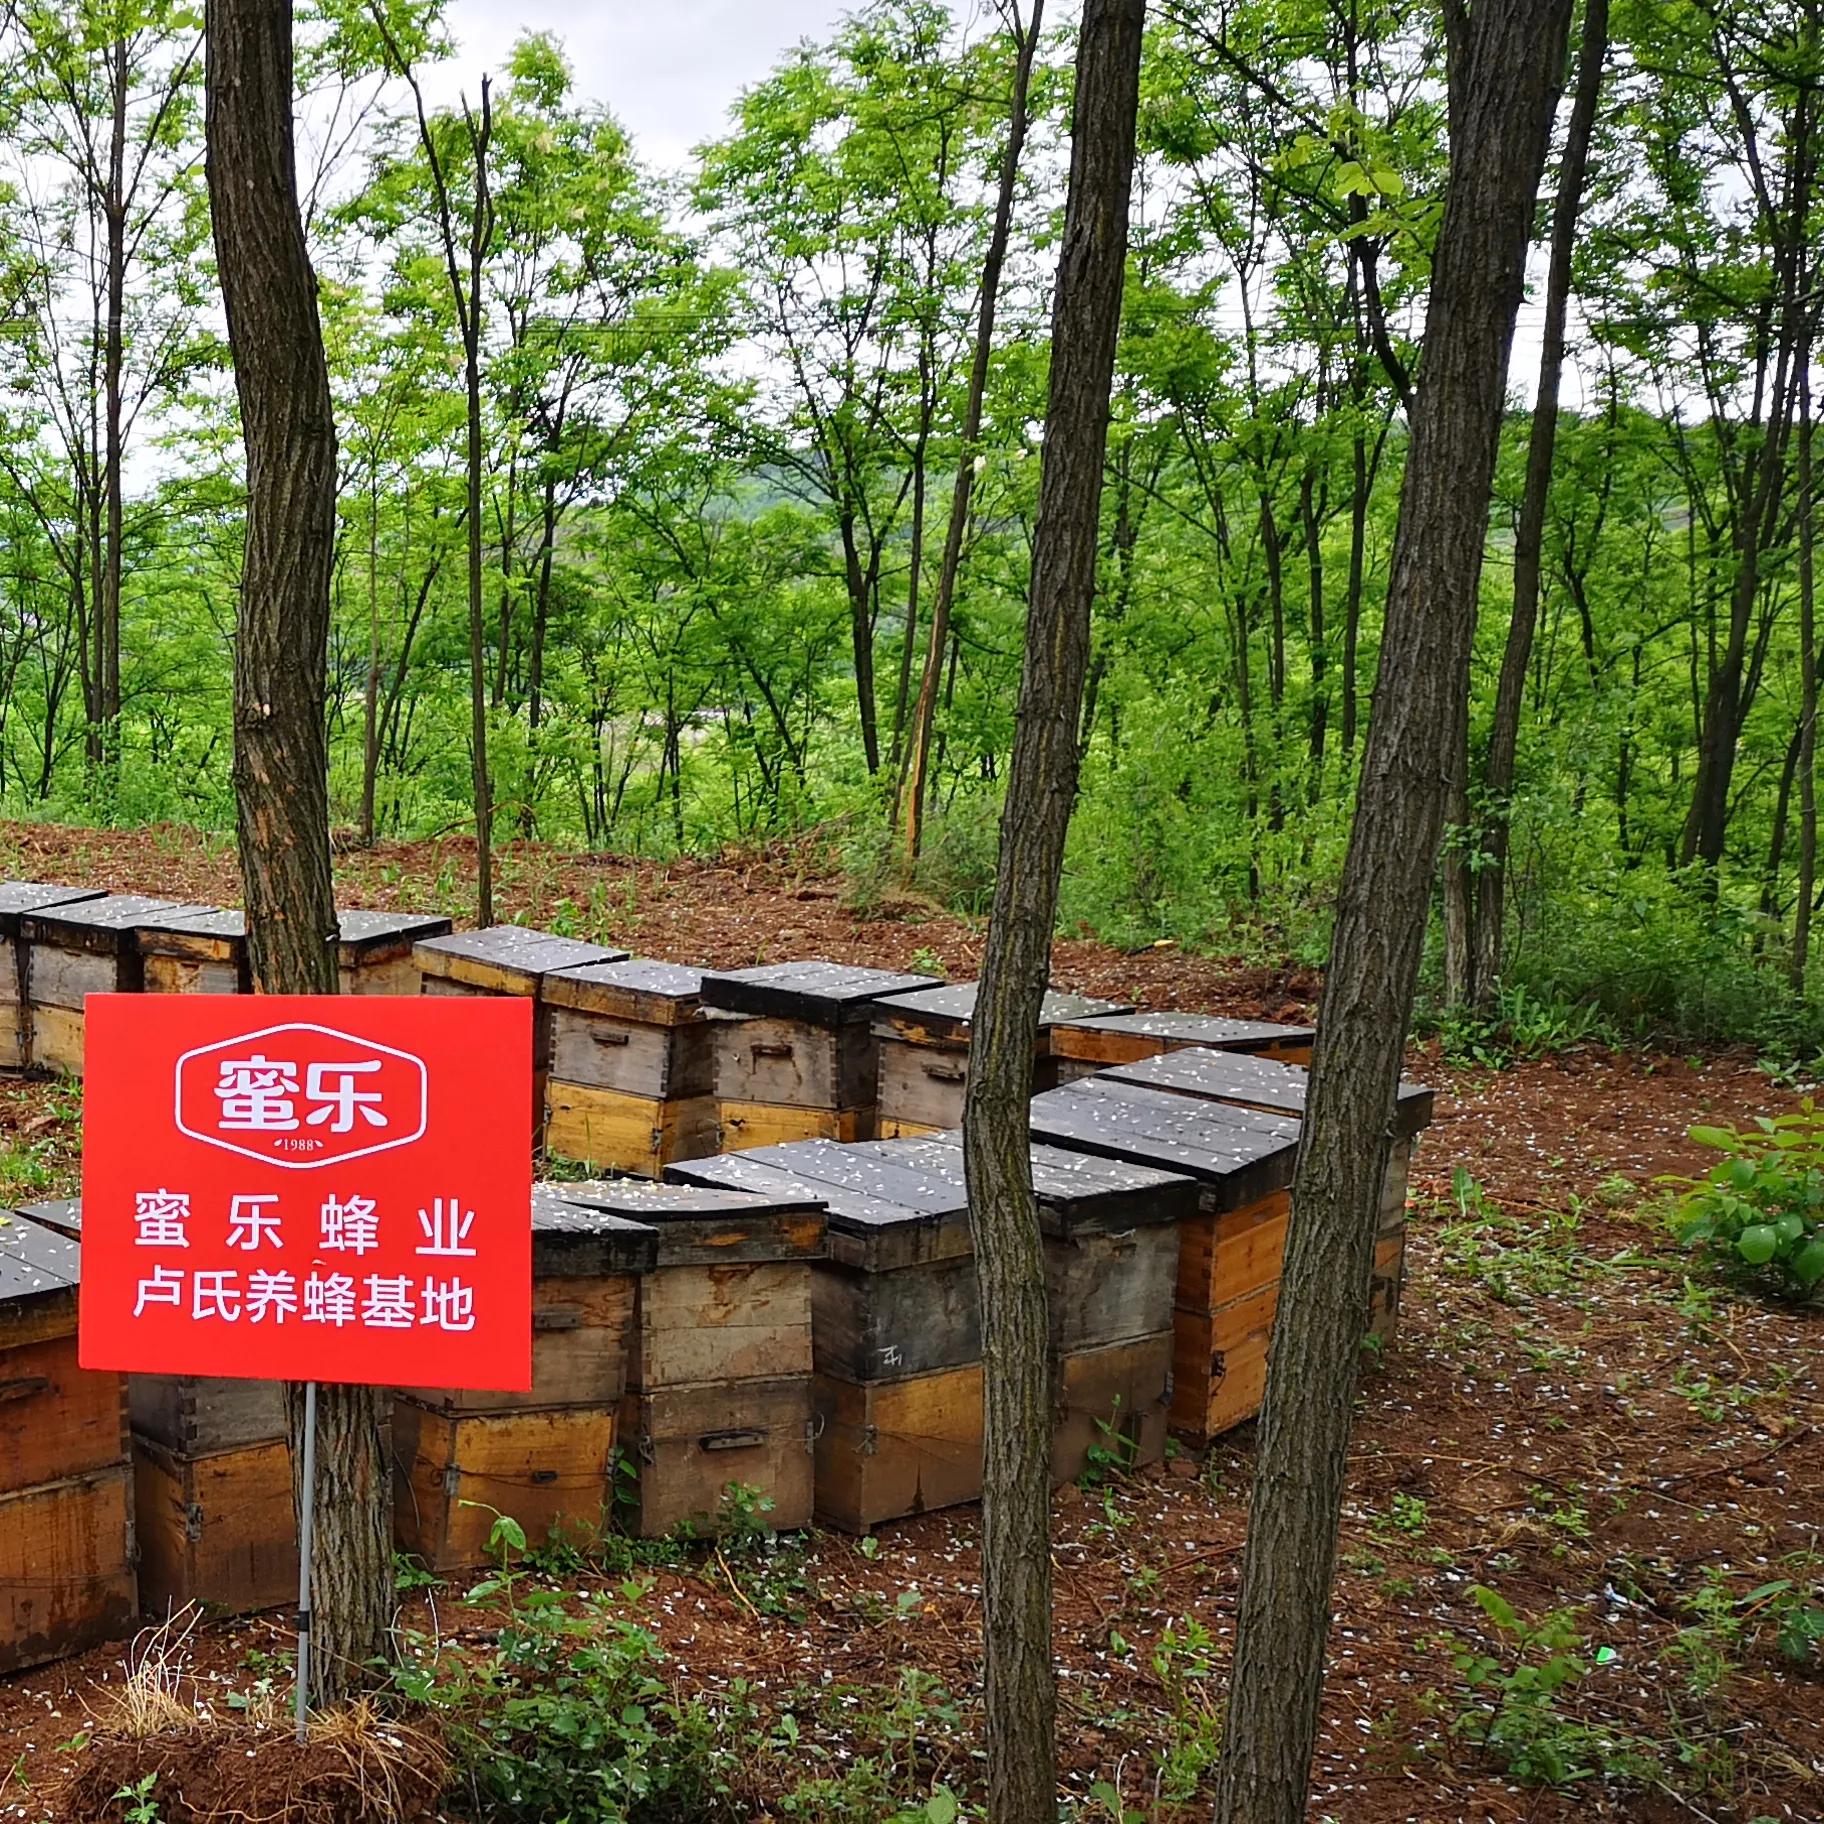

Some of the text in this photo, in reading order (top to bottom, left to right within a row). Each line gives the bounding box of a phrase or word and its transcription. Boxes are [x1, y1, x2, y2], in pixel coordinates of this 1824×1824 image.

[214, 1055, 388, 1133] 蜜乐
[284, 1138, 314, 1151] 1988
[133, 1188, 477, 1257] 蜜乐蜂业
[133, 1264, 476, 1331] 卢氏养蜂基地
